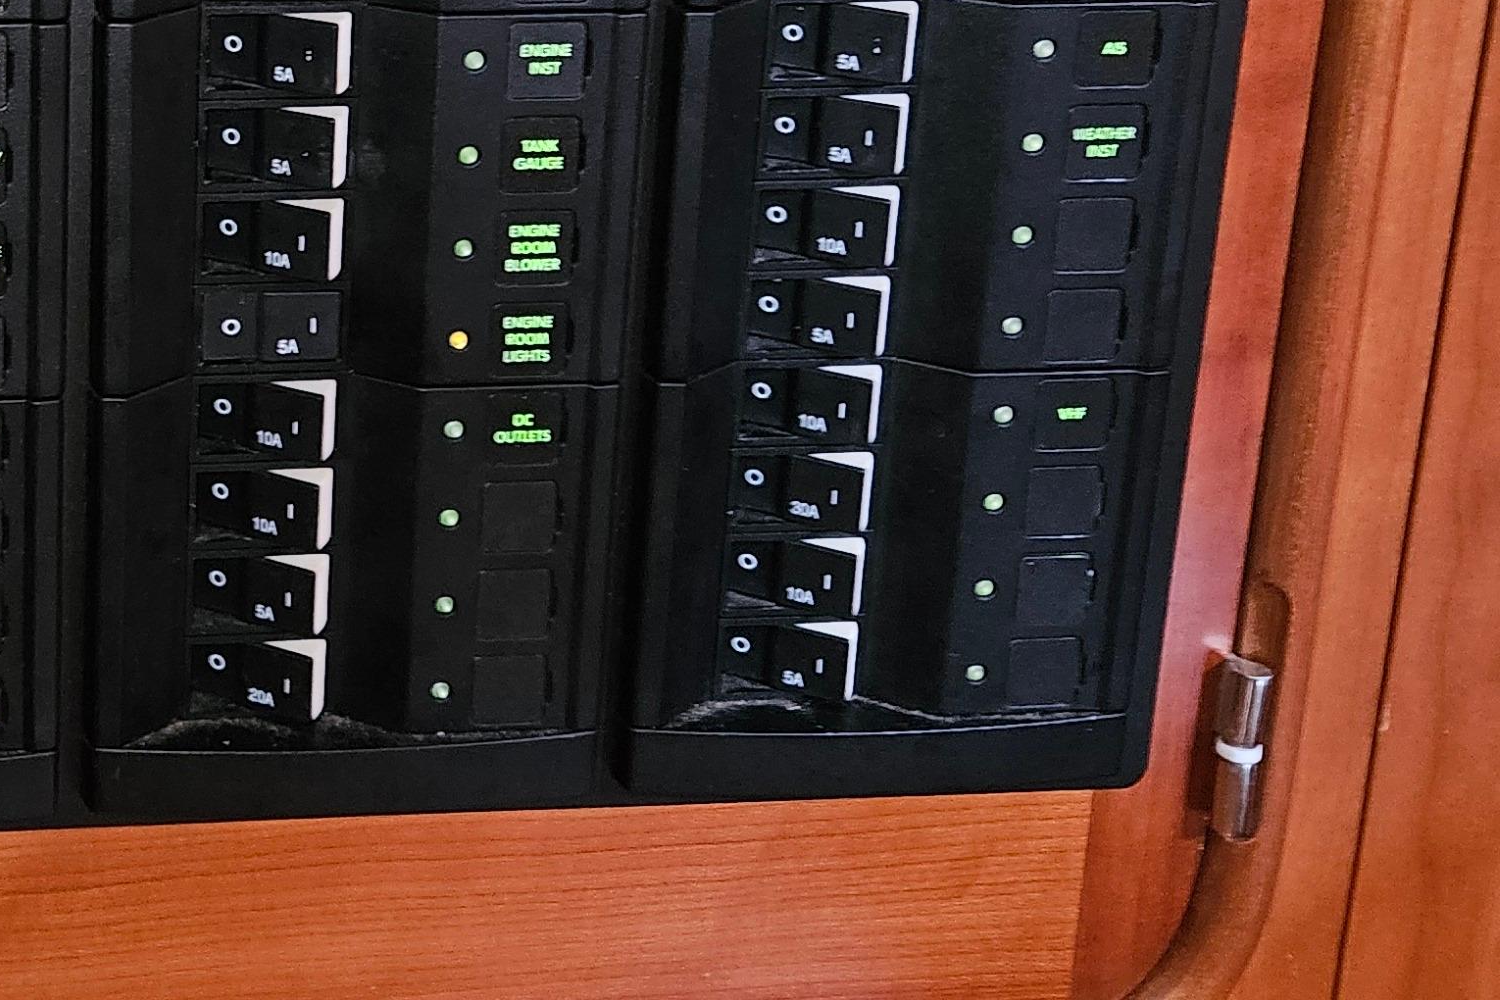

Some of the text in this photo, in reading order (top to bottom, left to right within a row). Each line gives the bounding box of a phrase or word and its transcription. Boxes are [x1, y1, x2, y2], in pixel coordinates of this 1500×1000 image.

[520, 44, 572, 57] ENGINE
[274, 66, 294, 82] 5A
[529, 62, 561, 74] INST
[521, 140, 559, 152] TANK
[271, 159, 291, 175] 5A
[513, 157, 564, 170] GAUGE
[509, 224, 560, 237] ENGINE
[511, 241, 556, 254] ROOM
[265, 251, 290, 268] 10A
[505, 258, 561, 271] BLOWER
[503, 316, 554, 328] ENGINE
[505, 333, 549, 345] ROOM
[812, 328, 833, 344] 5A
[277, 339, 298, 354] 5A
[503, 349, 550, 363] LIGHTS
[512, 414, 534, 426] DC
[257, 431, 282, 448] 10A
[493, 430, 551, 443] OUTLETS
[253, 517, 277, 535] 10A
[255, 604, 274, 621] 5A
[783, 671, 804, 687] 5A
